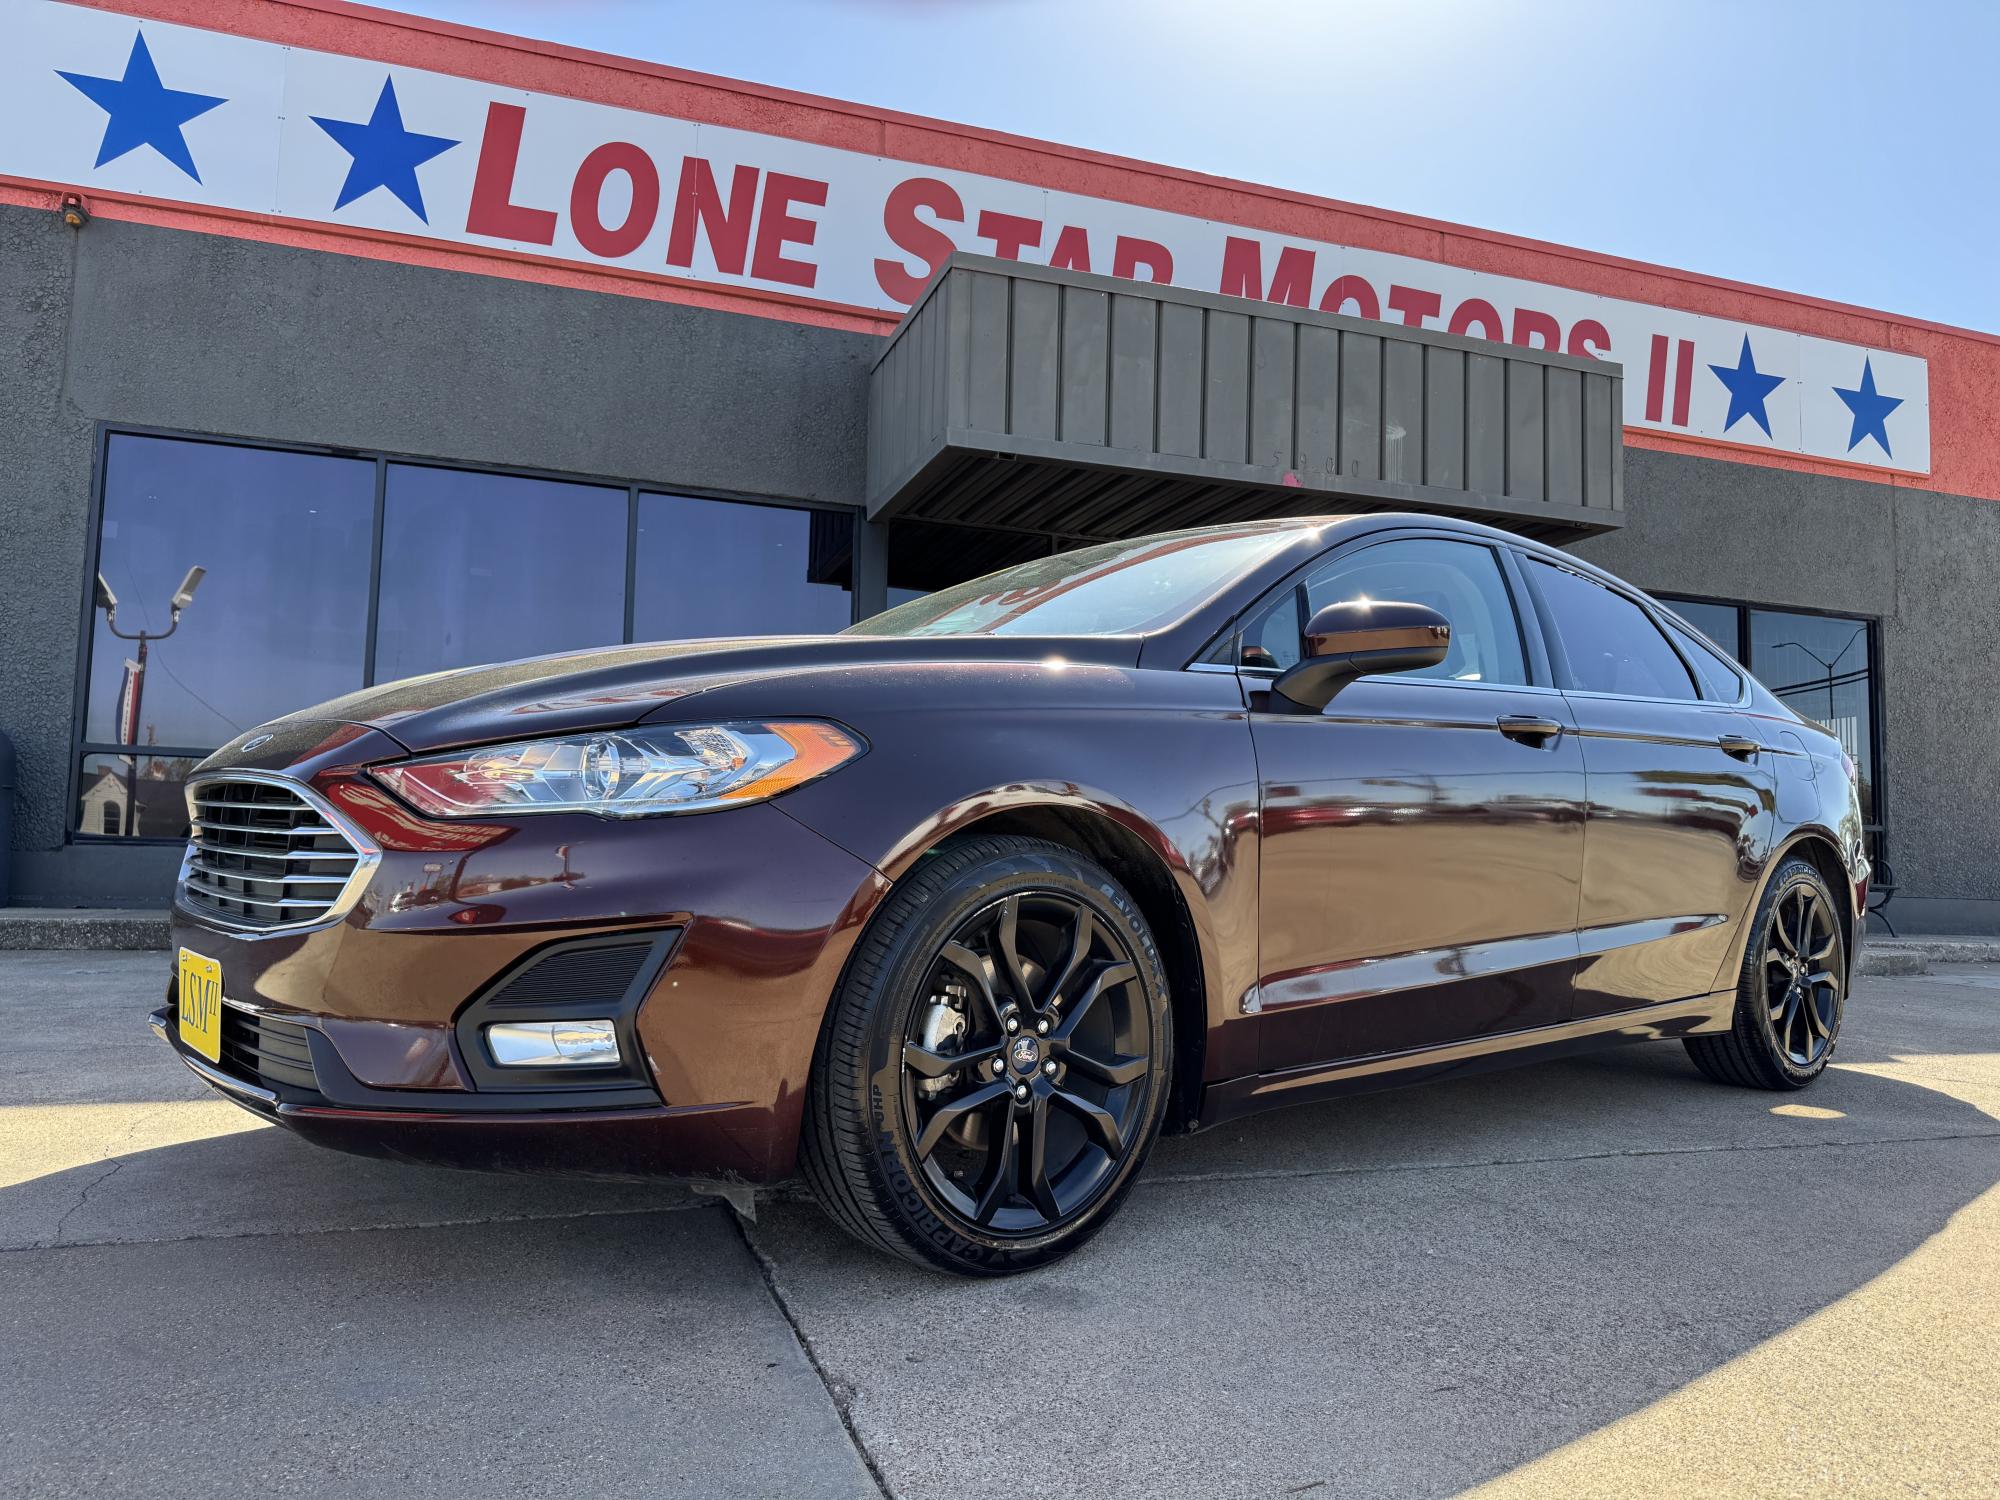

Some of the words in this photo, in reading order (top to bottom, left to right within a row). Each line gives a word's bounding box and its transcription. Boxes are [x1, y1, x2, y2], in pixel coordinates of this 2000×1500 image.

[466, 101, 829, 288] LONE
[1645, 334, 1695, 427] II
[872, 1084, 885, 1122] UHP
